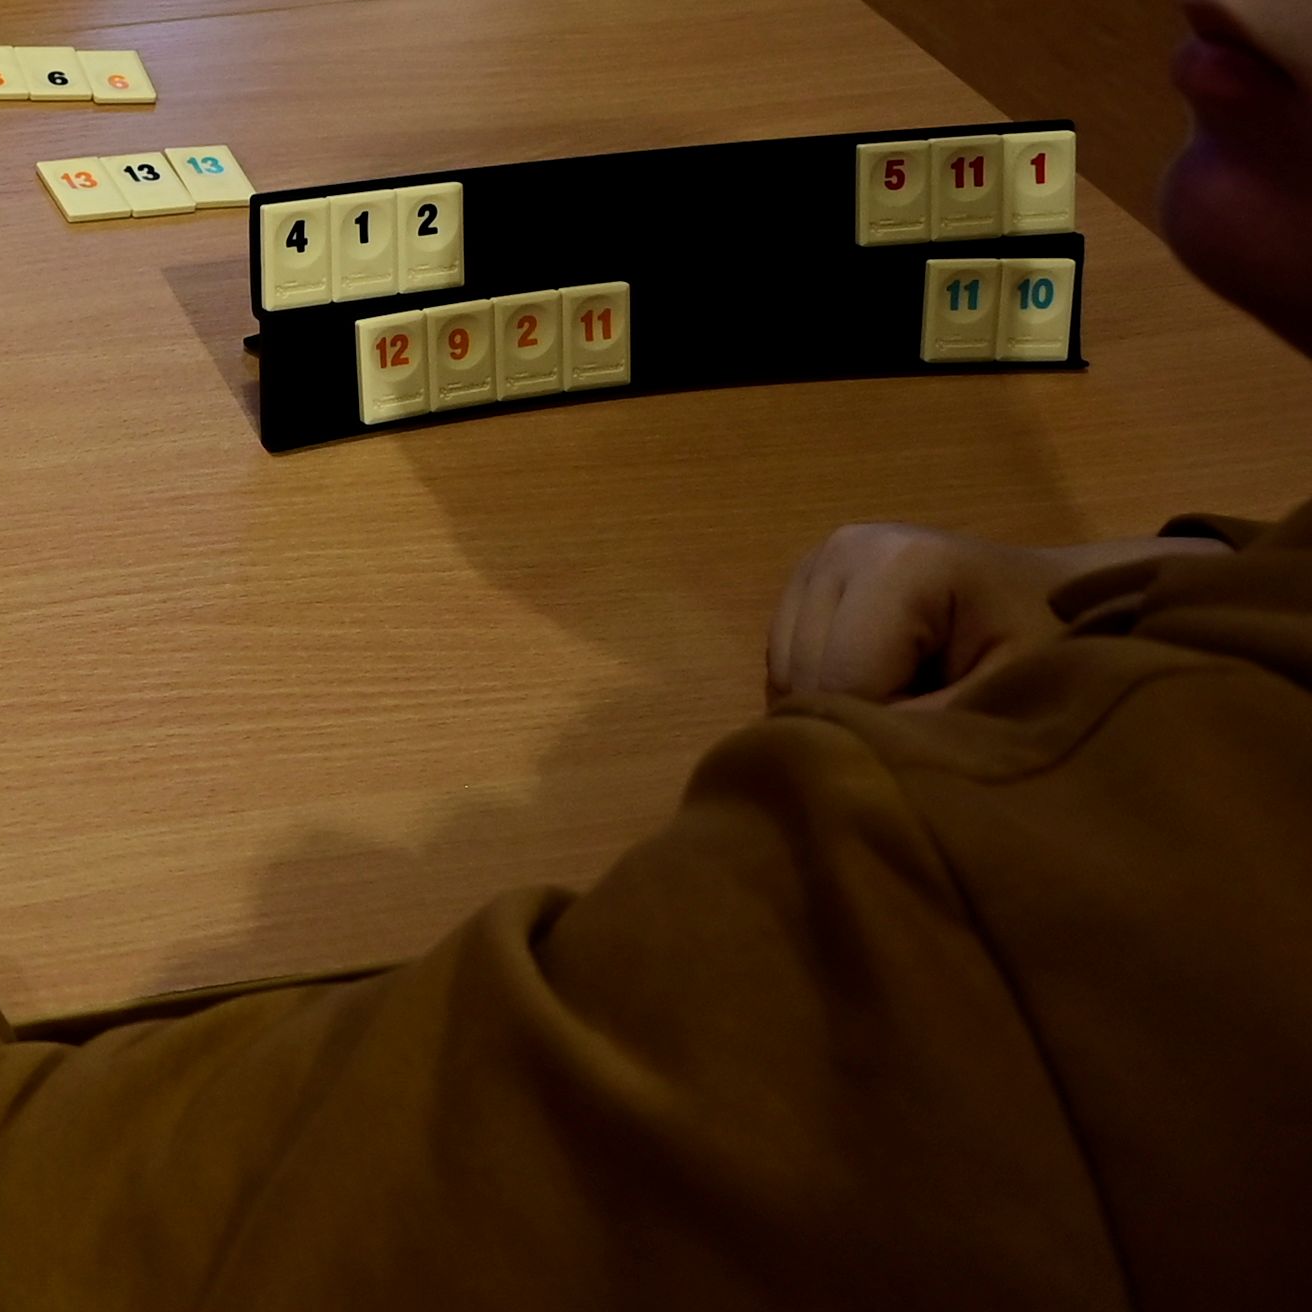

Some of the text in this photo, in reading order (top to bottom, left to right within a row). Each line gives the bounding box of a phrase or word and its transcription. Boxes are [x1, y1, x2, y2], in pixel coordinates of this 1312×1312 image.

[47, 71, 68, 85] 6
[107, 75, 128, 88] 6
[61, 156, 223, 188] 13 13 13
[884, 153, 1046, 190] 5 11 1
[286, 203, 439, 253] 4 1 2
[946, 278, 1054, 311] 11 10
[376, 308, 612, 369] 12 9 2 11
